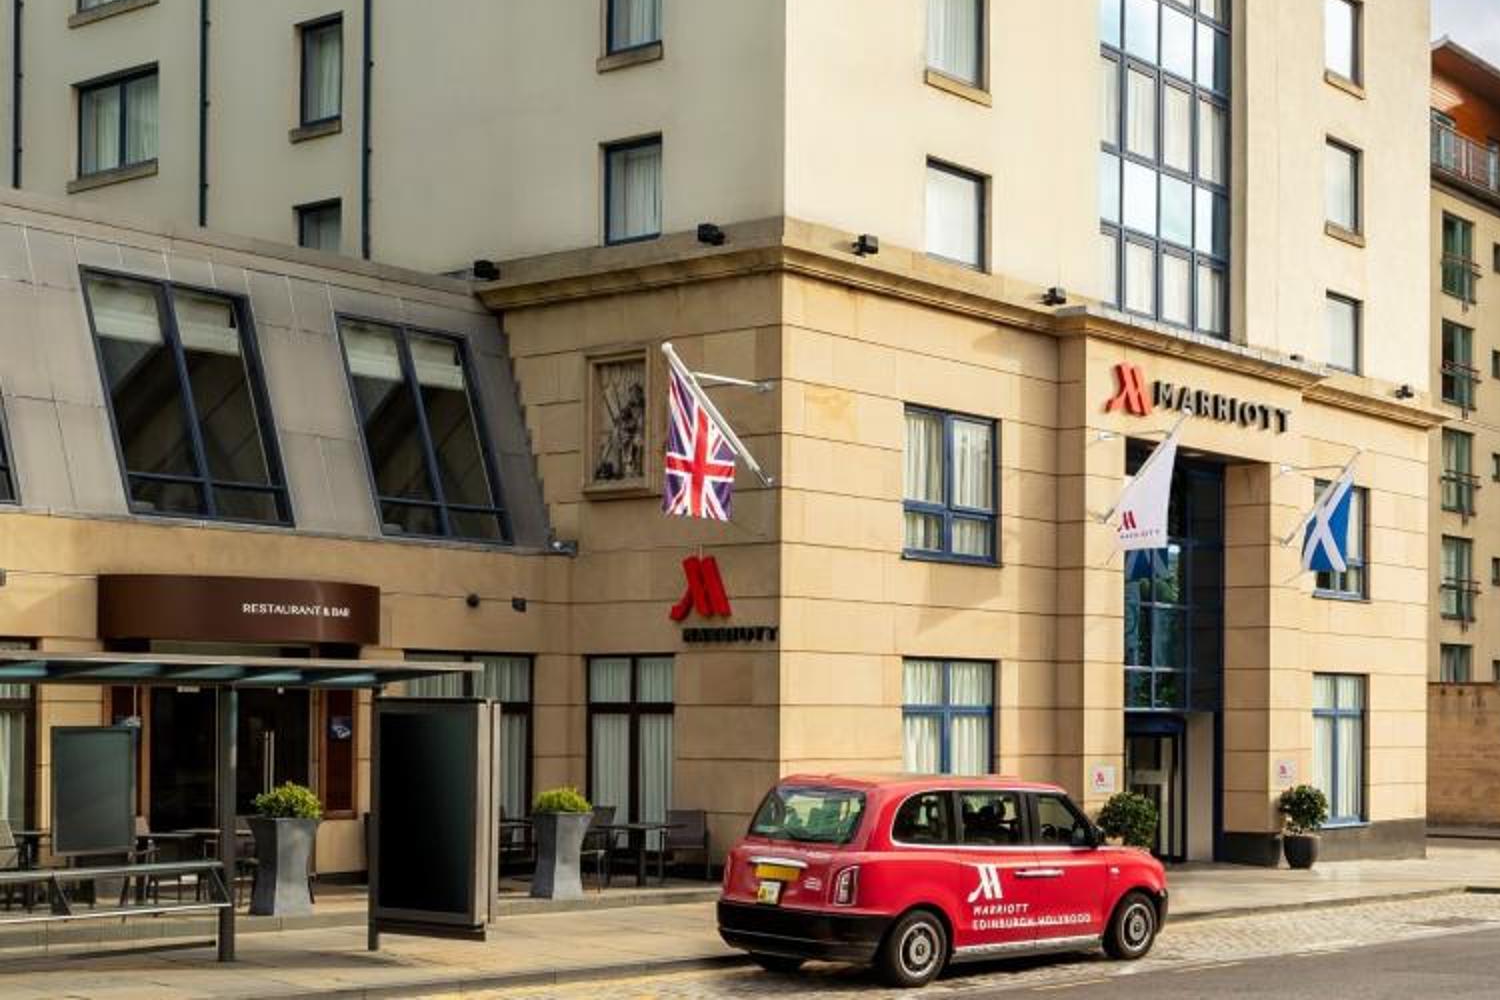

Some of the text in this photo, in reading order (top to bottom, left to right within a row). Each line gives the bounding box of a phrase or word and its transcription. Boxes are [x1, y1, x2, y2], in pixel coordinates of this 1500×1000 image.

[1153, 380, 1291, 433] MARRIOTT
[242, 602, 321, 616] RESTAURANT
[331, 606, 350, 618] BAR
[973, 903, 1030, 917] MARRIOTT
[972, 916, 1034, 931] EDINBURGH
